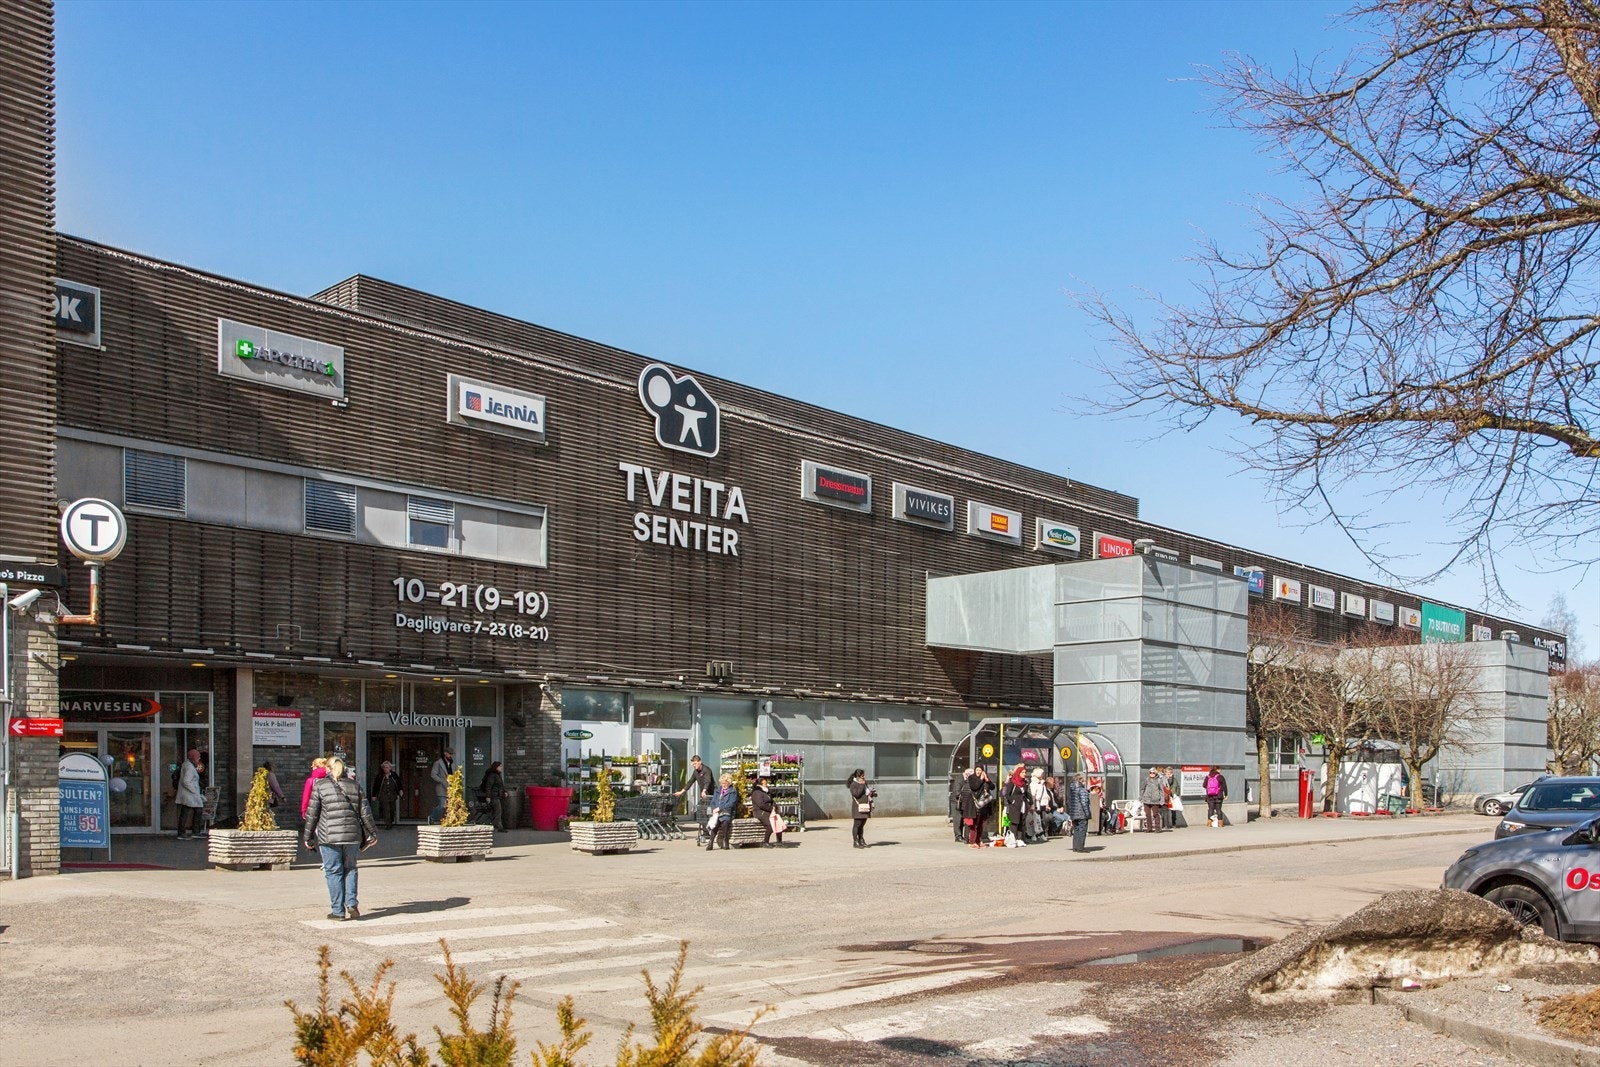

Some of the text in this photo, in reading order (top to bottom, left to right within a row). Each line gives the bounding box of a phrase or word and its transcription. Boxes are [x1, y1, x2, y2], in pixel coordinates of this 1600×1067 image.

[619, 462, 749, 523] TVEITA
[819, 476, 865, 496] Dressmann
[908, 497, 949, 516] VIVIKES
[80, 513, 110, 547] T
[633, 512, 738, 556] SENTER
[1103, 543, 1130, 556] LINDEX
[0, 569, 45, 582] o's Pizza
[393, 577, 549, 619] 10-21 (9-19)
[396, 613, 549, 641] Dagligvare 7-23 (8-21)
[60, 701, 142, 712] NARVESEN
[389, 711, 473, 728] Velkommen
[60, 788, 103, 800] SULTEN?
[79, 815, 98, 831] 59
